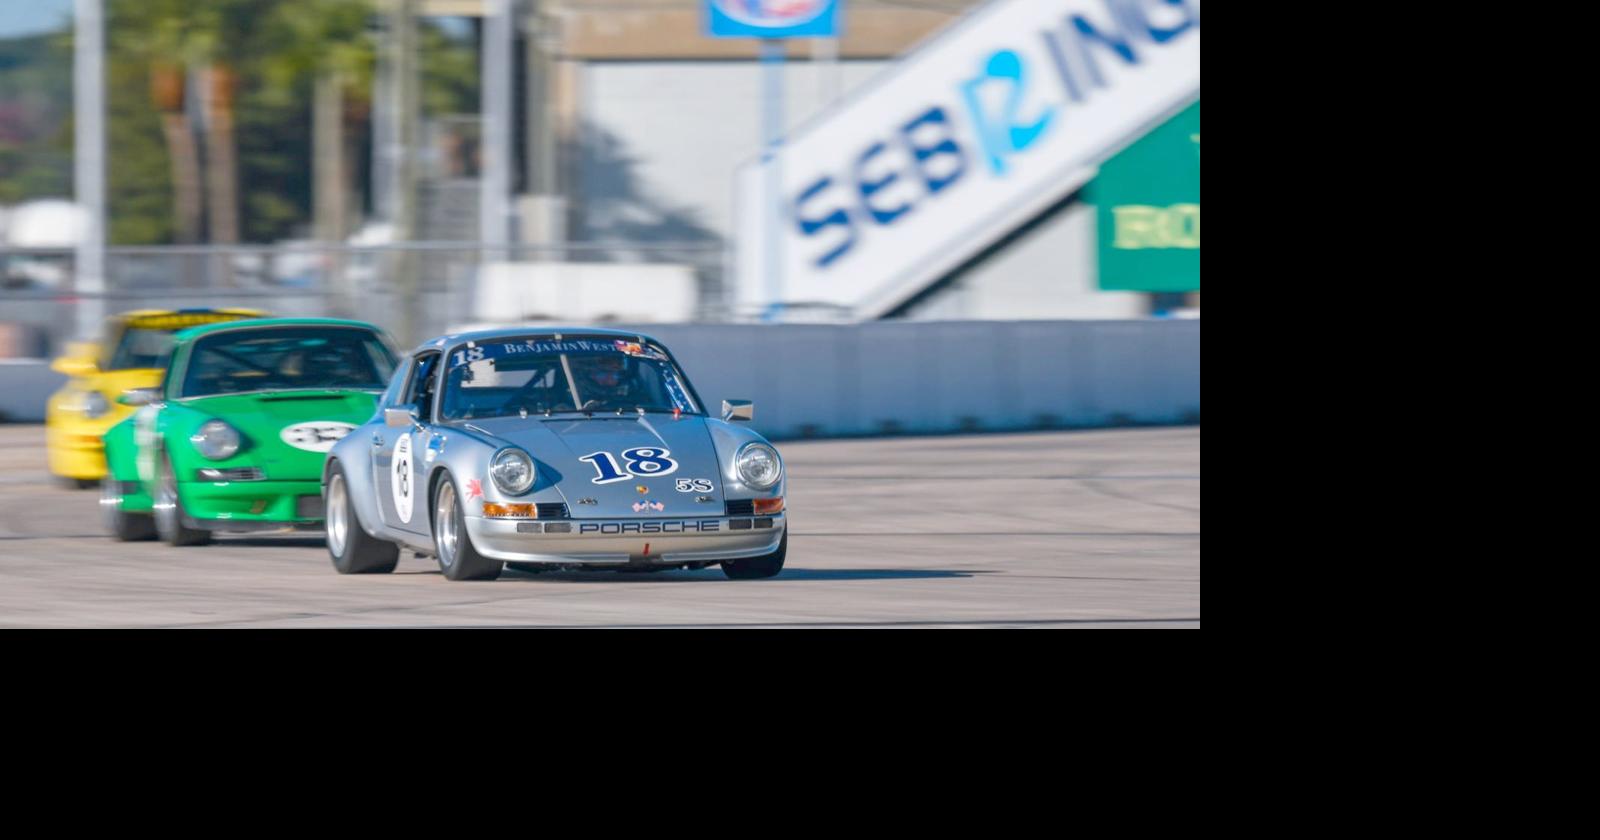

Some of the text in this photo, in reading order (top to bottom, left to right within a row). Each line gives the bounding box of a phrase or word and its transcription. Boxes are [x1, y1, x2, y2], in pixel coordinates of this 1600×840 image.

[453, 346, 485, 367] 18
[579, 446, 678, 484] 18
[675, 478, 714, 492] 5S
[579, 519, 720, 535] PORSCHE
